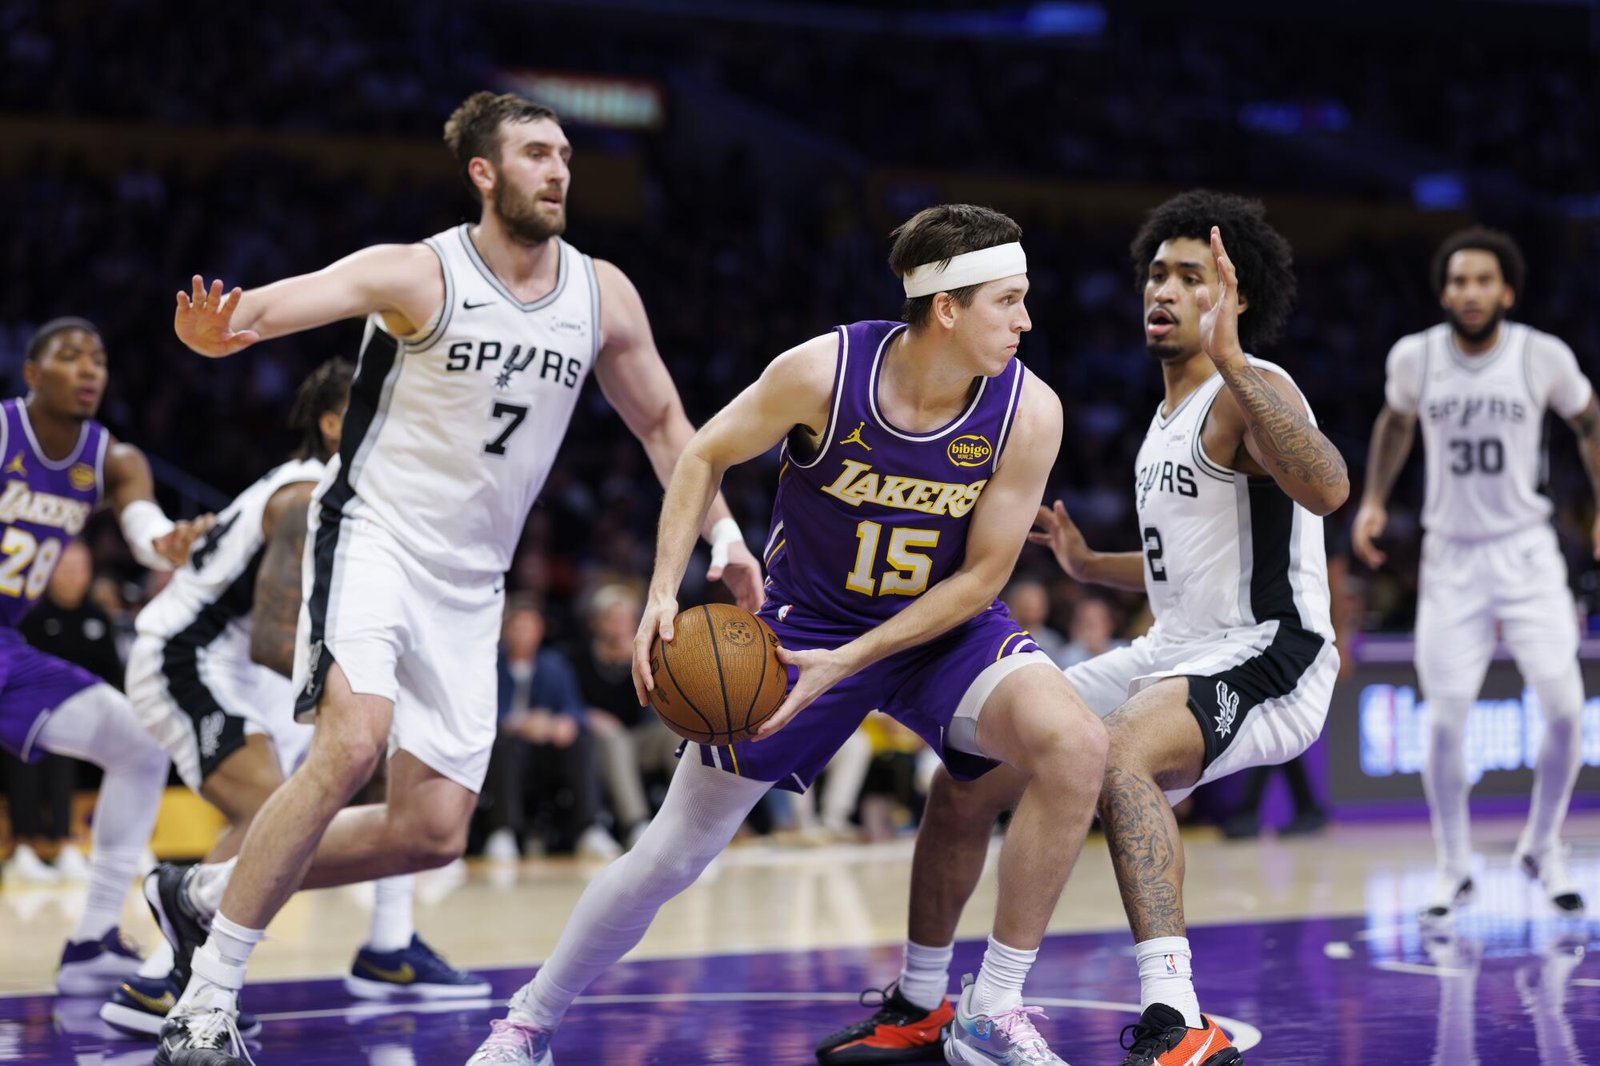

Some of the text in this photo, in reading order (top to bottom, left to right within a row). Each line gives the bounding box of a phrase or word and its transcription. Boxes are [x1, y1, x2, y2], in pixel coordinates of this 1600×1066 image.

[446, 342, 581, 390] SPURS
[484, 403, 528, 455] 7
[951, 443, 989, 458] bibigo
[1449, 438, 1505, 476] 30
[820, 459, 988, 518] LAKERS
[845, 520, 941, 597] 15
[1144, 527, 1168, 581] 2
